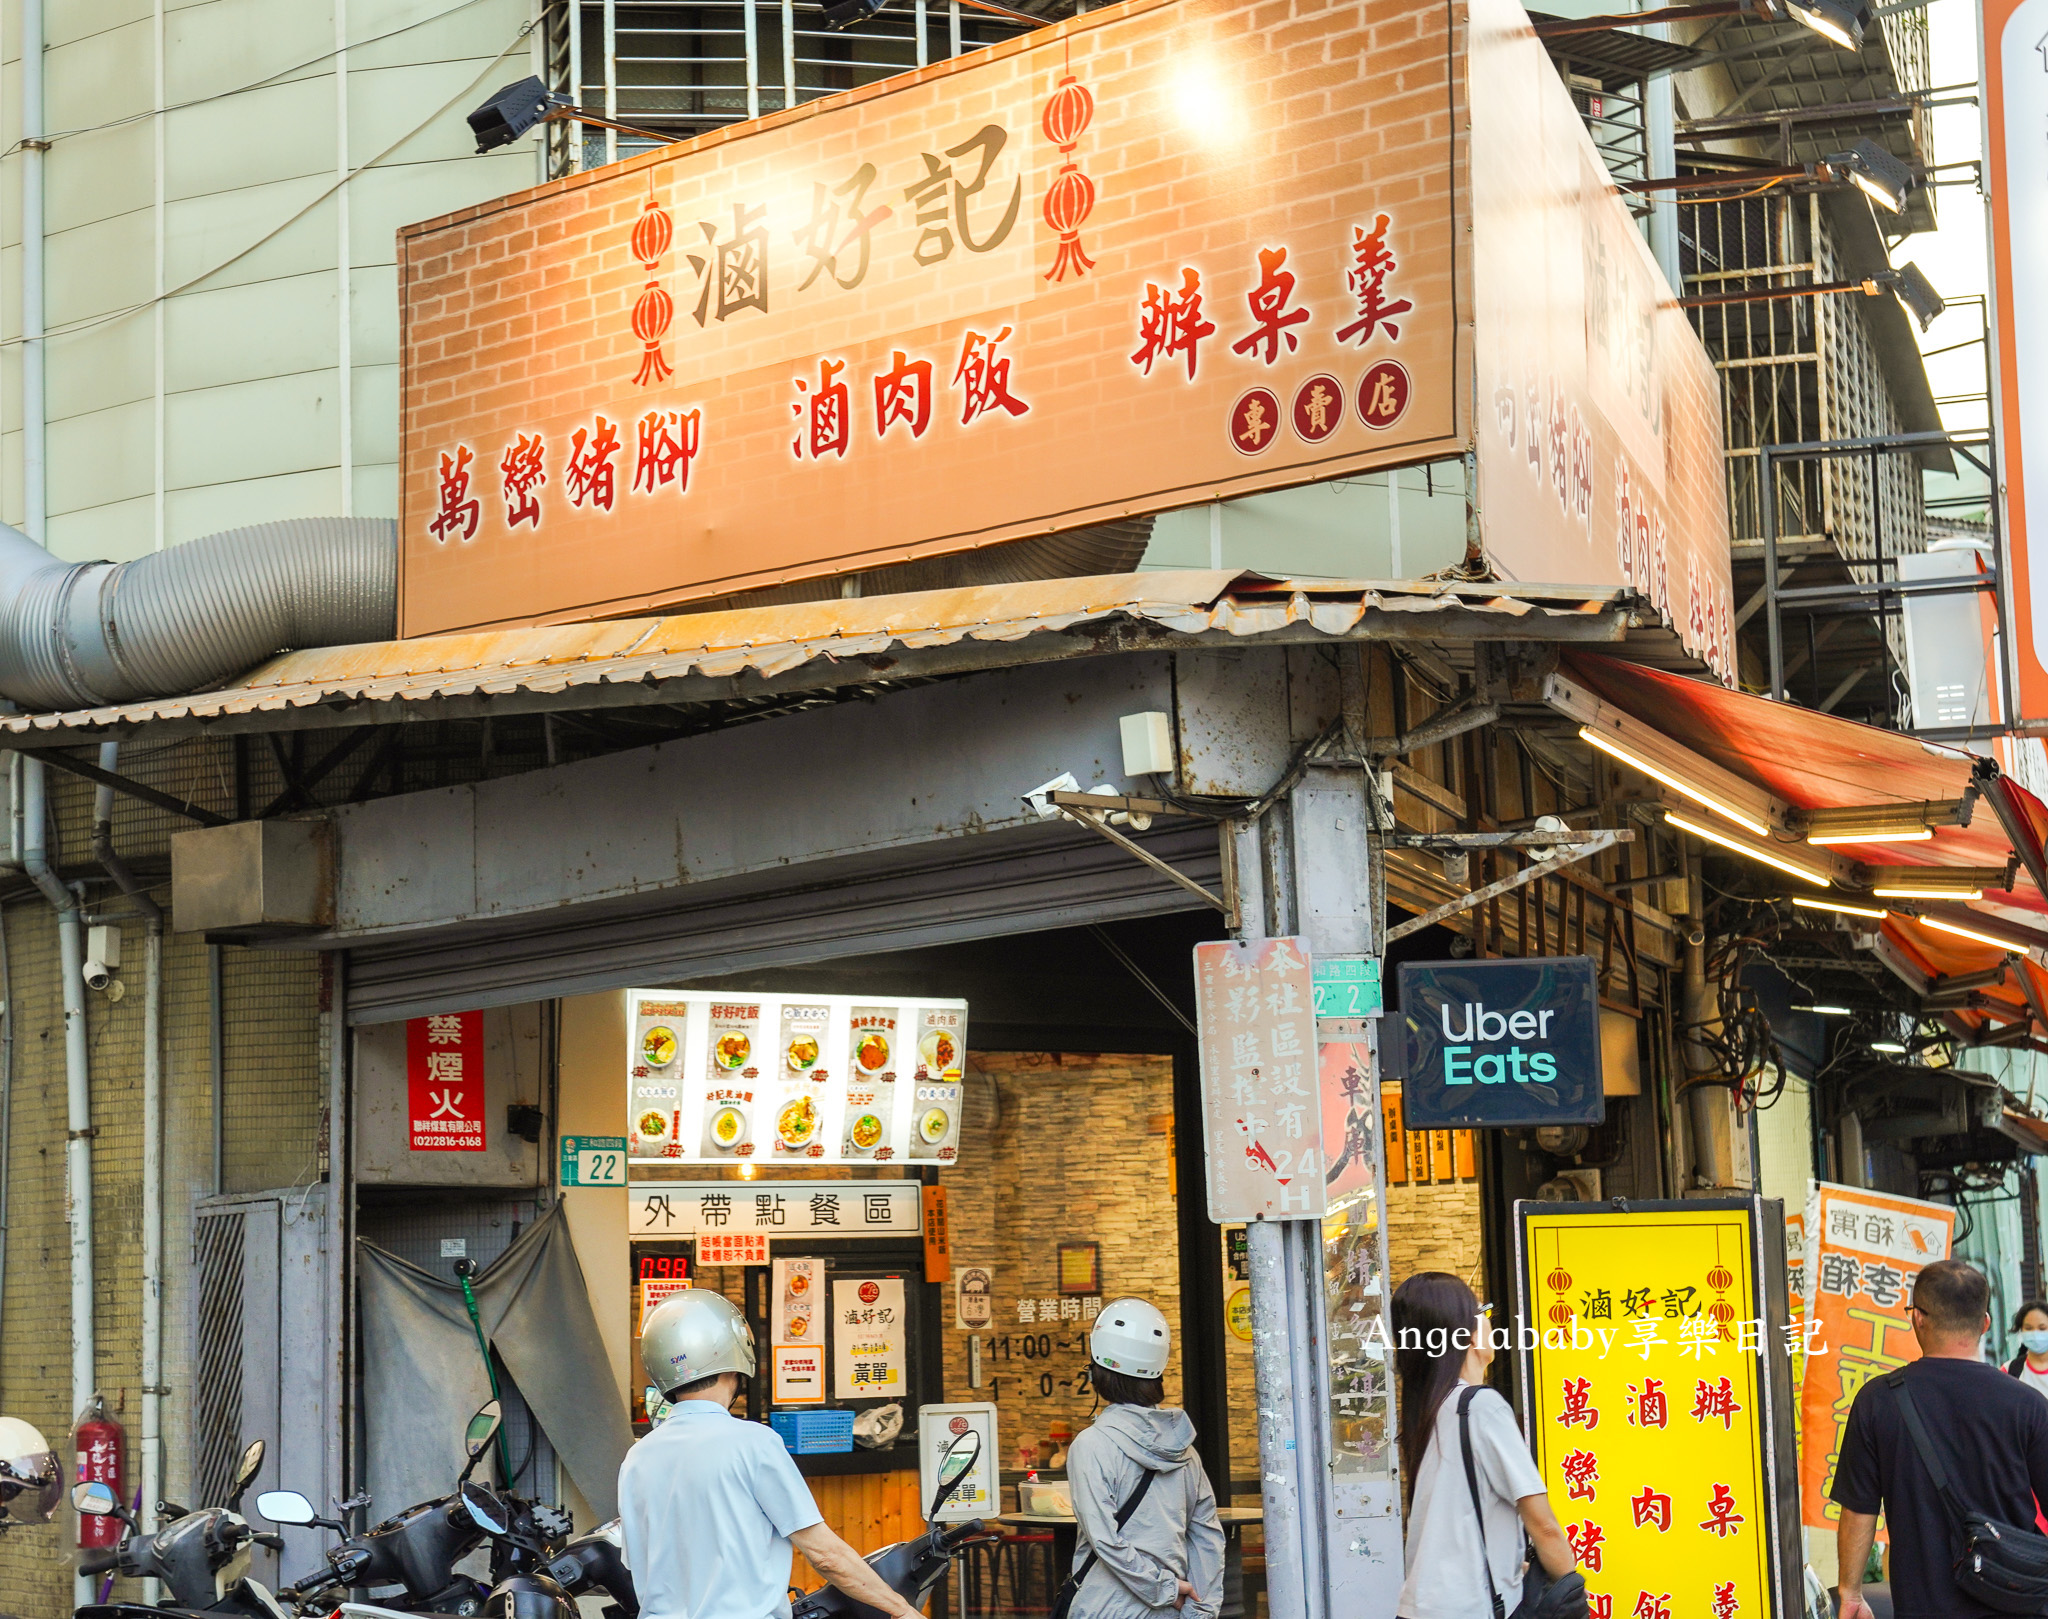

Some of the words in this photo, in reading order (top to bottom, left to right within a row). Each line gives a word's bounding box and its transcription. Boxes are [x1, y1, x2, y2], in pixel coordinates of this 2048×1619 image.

[686, 124, 1022, 328] 滷好記
[792, 326, 1030, 460] 滷肉飯
[1239, 373, 1398, 446] 專賣店
[429, 408, 701, 542] 萬巒豬腳
[711, 1005, 759, 1019] 好好吃飯
[1441, 1002, 1555, 1043] Uber
[426, 1015, 465, 1119] 禁煙火
[1443, 1046, 1558, 1086] Eats
[413, 1136, 482, 1148] (02)2816-6168
[590, 1154, 617, 1180] 22
[644, 1193, 892, 1227] 外帶點餐區
[701, 1236, 765, 1248] 結帳當面點清
[844, 1308, 895, 1325] 滷好記
[1017, 1297, 1102, 1323] 營業時間
[1579, 1285, 1703, 1321] 滷好記
[670, 1354, 687, 1365] SYM
[854, 1362, 888, 1384] 黃單
